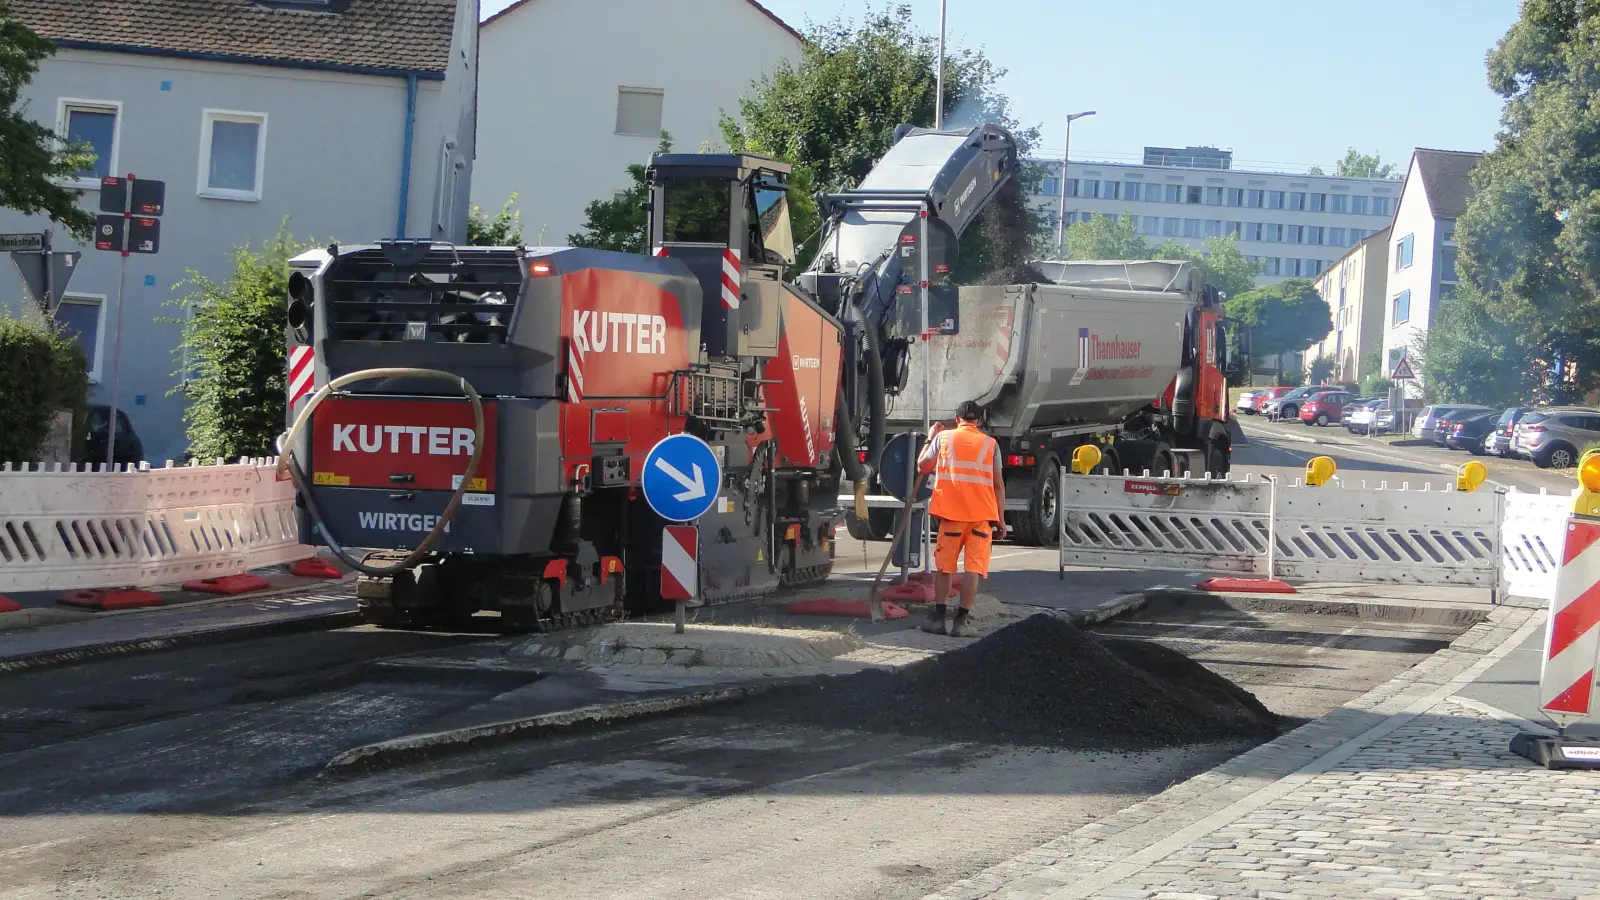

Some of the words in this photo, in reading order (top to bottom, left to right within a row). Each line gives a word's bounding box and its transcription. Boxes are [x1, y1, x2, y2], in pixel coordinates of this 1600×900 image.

[573, 309, 667, 354] KUTTER
[1091, 334, 1142, 360] Thannhauser
[333, 423, 476, 456] KUTTER
[799, 395, 815, 464] KUTTER
[358, 511, 450, 533] WIRTGEN
